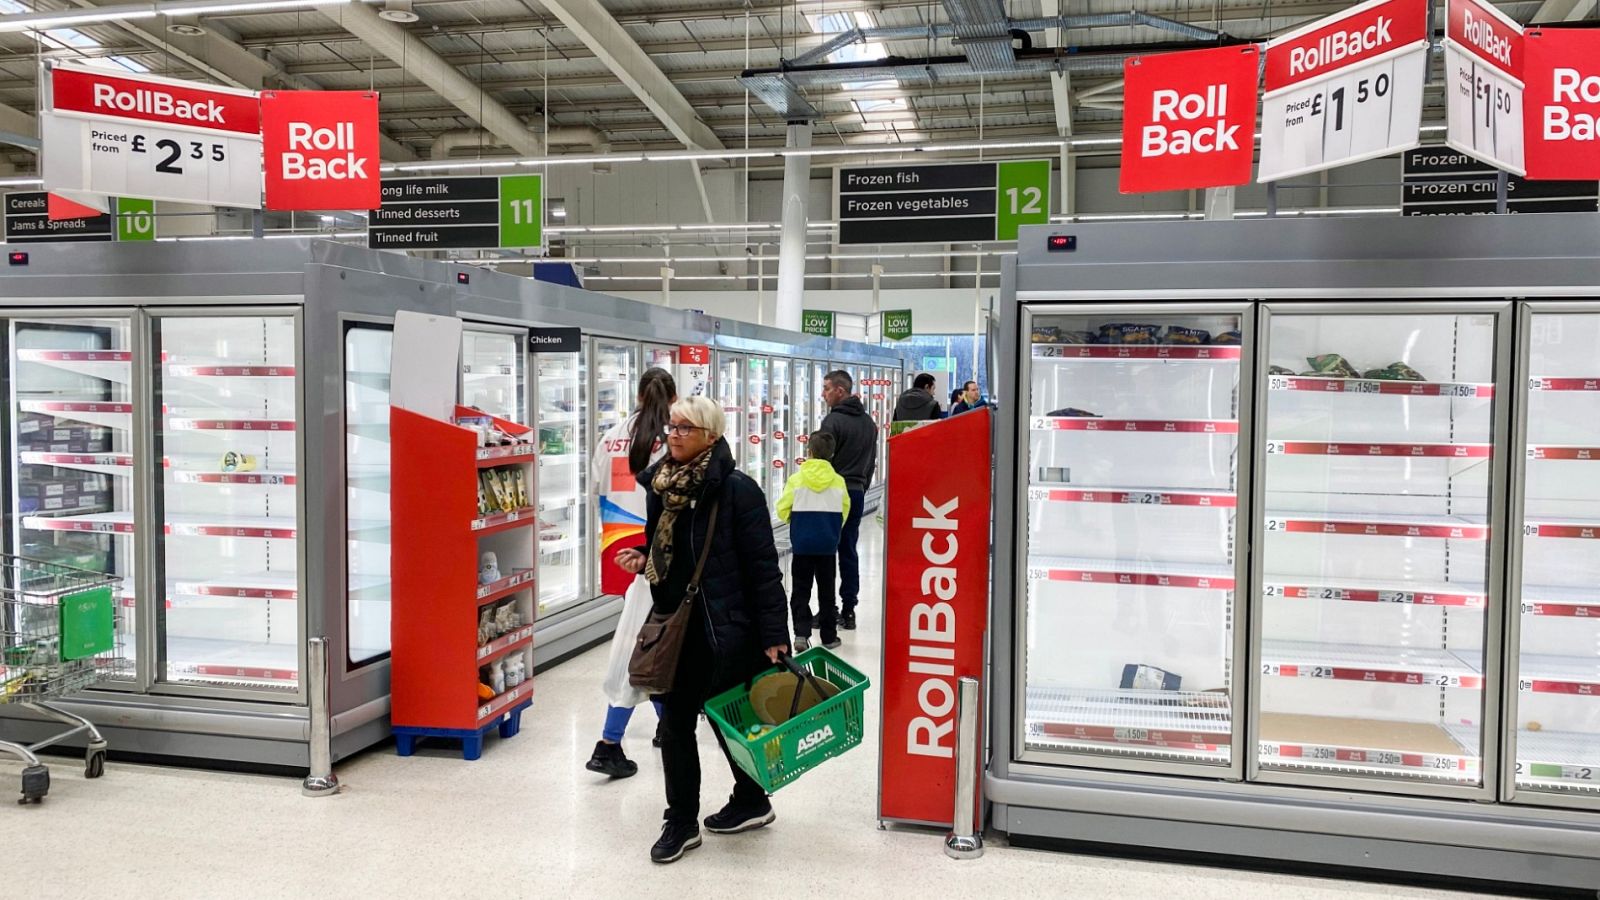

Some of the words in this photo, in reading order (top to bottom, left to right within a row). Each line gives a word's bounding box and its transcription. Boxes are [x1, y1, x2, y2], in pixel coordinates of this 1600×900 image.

[1464, 9, 1512, 67] RollBack
[1289, 16, 1393, 77] RollBack
[1459, 67, 1473, 85] Priced
[1460, 83, 1470, 97] from
[1553, 68, 1600, 103] Ro
[93, 82, 225, 124] RollBack
[1152, 83, 1228, 122] Roll
[1286, 98, 1310, 113] Priced
[1285, 117, 1304, 128] from
[1543, 105, 1600, 141] Ba
[91, 130, 127, 143] Priced
[288, 121, 354, 151] Roll
[1141, 119, 1240, 158] Back
[92, 143, 120, 154] from
[281, 152, 368, 180] Back
[1412, 154, 1467, 166] Frozen
[848, 174, 893, 185] Frozen
[897, 172, 919, 183] fish
[382, 186, 403, 197] ong
[406, 184, 423, 195] life
[426, 184, 449, 194] milk
[1411, 183, 1467, 195] Frozen
[1472, 181, 1515, 192] chis
[11, 198, 46, 209] Cereals
[848, 199, 893, 211] Frozen
[897, 196, 969, 211] vegetables
[1006, 187, 1042, 215] 12
[376, 209, 412, 219] Tinned
[415, 206, 460, 219] desserts
[510, 199, 533, 225] 11
[11, 219, 35, 230] Jams
[37, 219, 45, 229] &
[47, 218, 86, 231] Spreads
[124, 210, 150, 235] 10
[376, 232, 413, 243] Tinned
[415, 232, 438, 242] fruit
[805, 319, 828, 327] LOW
[888, 319, 909, 327] LOW
[530, 336, 562, 344] Chicken
[906, 495, 959, 759] RollBack
[797, 724, 834, 754] ASDA
